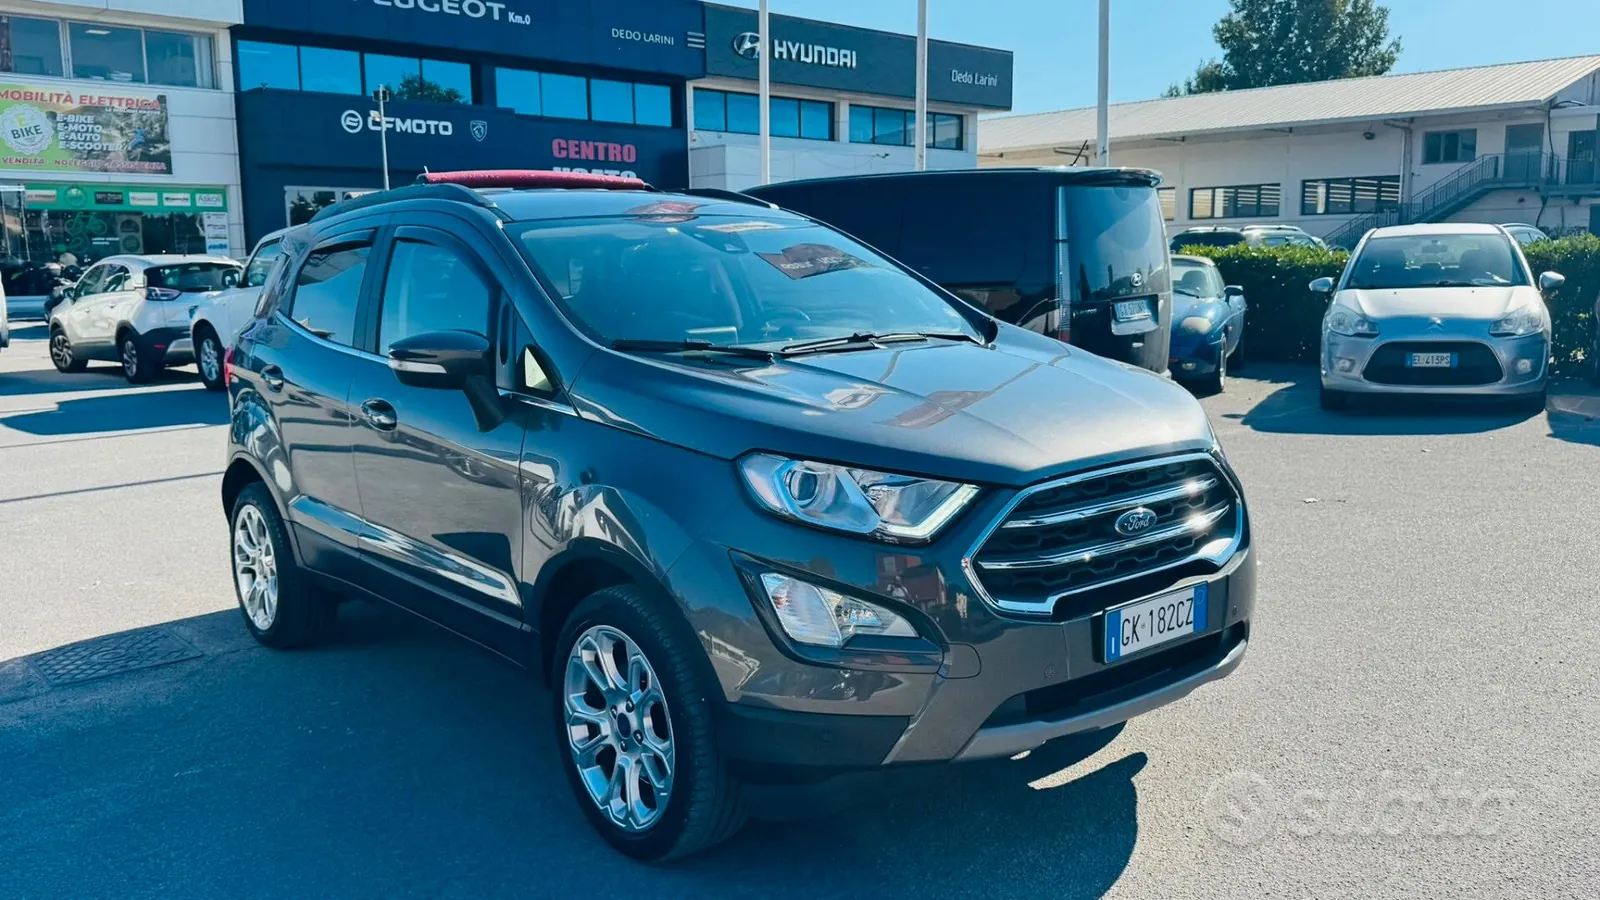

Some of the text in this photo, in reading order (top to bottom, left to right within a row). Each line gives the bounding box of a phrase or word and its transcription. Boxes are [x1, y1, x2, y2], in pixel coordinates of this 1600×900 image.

[372, 0, 531, 25] GEOT Km.0
[611, 27, 674, 46] DEDO LARINI
[773, 38, 857, 69] HYUNDAI
[951, 69, 998, 87] Dedo Larini
[0, 90, 74, 104] MOBILITÀ
[56, 113, 95, 124] E-BIKE
[367, 116, 453, 136] CFMOTO
[11, 124, 43, 140] BIKE
[57, 123, 103, 132] E-MOTO
[58, 132, 101, 142] E-AUTO
[551, 138, 638, 163] CENTRO
[2, 157, 46, 165] VENDITA
[1124, 514, 1151, 531] Ford
[1121, 597, 1195, 647] GK 182CZ
